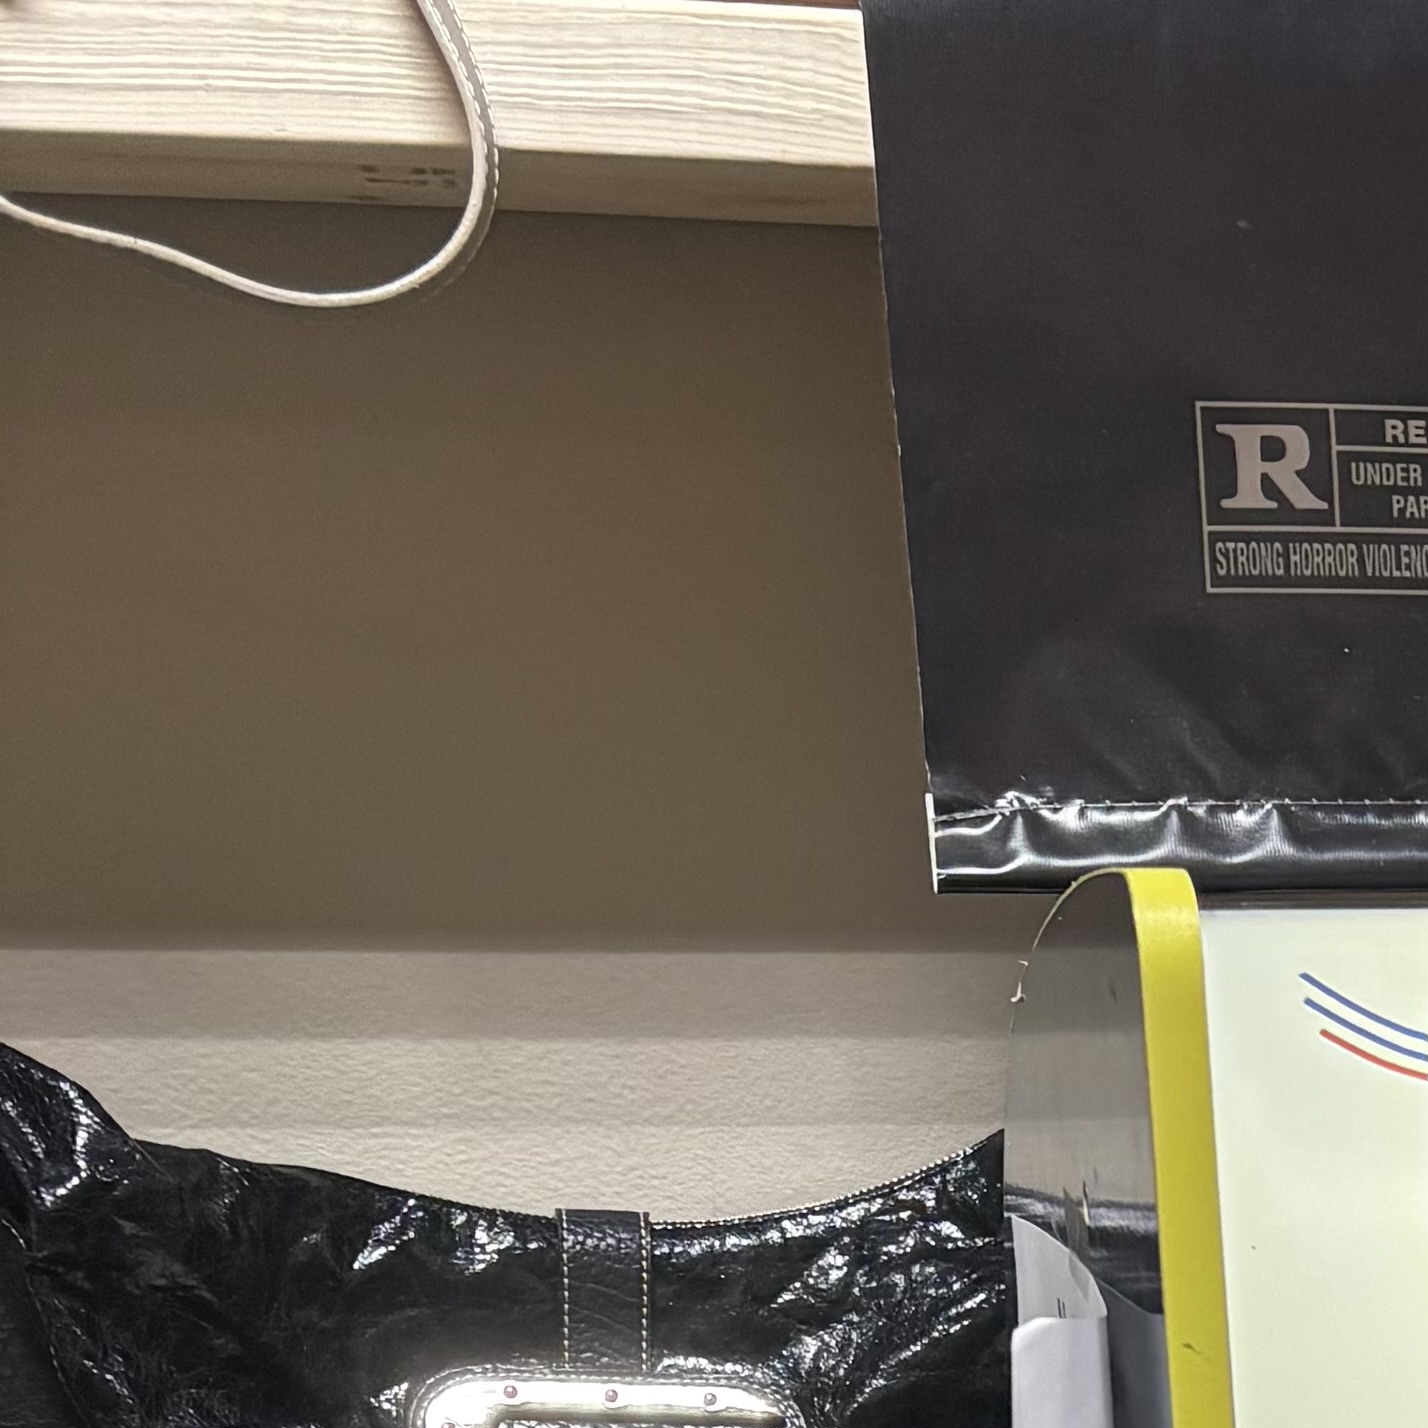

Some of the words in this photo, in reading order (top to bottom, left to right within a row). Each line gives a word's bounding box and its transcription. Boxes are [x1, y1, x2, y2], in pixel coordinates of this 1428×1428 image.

[1214, 423, 1329, 510] R
[1349, 461, 1425, 489] UNDER
[1214, 541, 1286, 578] STRONG
[1289, 541, 1359, 579] HORROR
